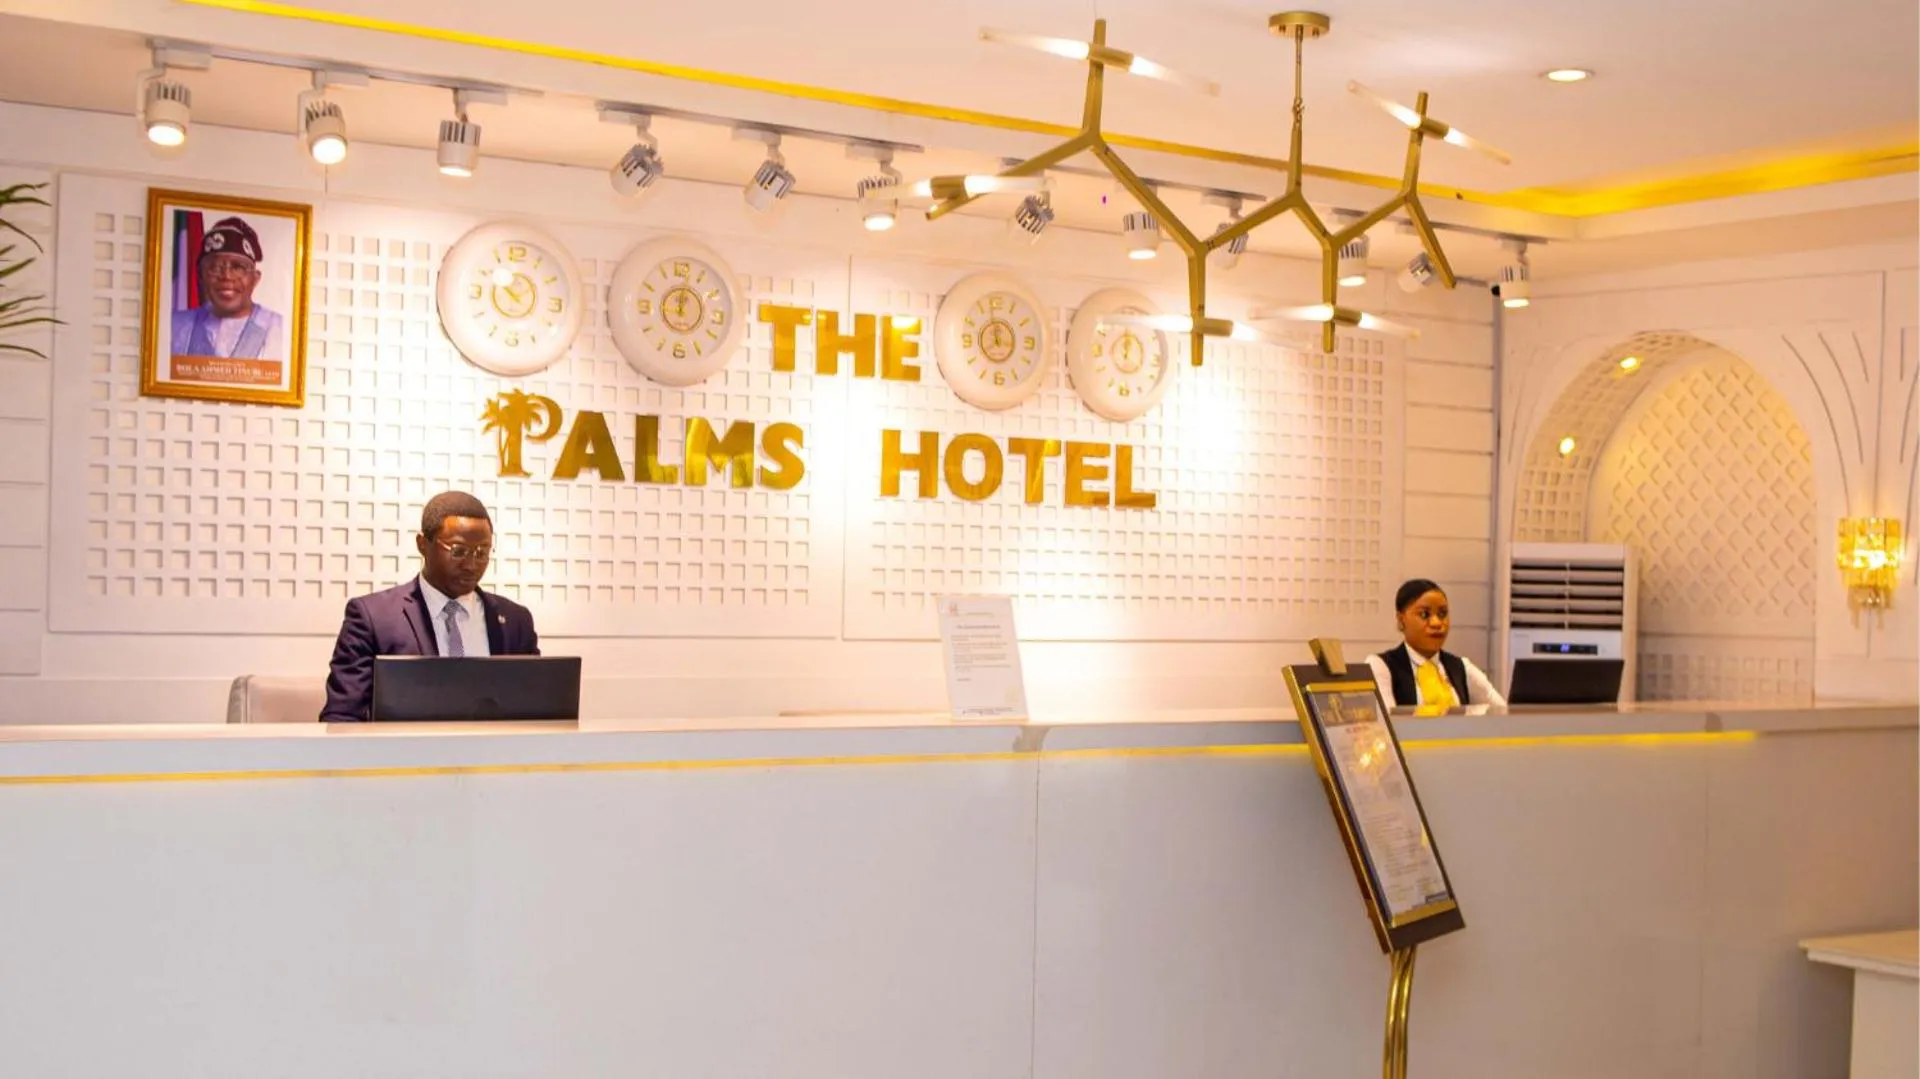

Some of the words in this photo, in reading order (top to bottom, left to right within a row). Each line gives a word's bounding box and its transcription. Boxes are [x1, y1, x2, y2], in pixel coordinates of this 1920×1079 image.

[509, 246, 527, 262] 12
[548, 297, 563, 313] 3
[637, 299, 651, 314] 9
[712, 310, 725, 325] 3
[673, 342, 686, 359] 6
[758, 304, 921, 381] THE
[1024, 336, 1035, 350] 3
[994, 371, 1005, 385] 6
[478, 388, 805, 489] PALMS
[880, 429, 1156, 508] HOTEL
